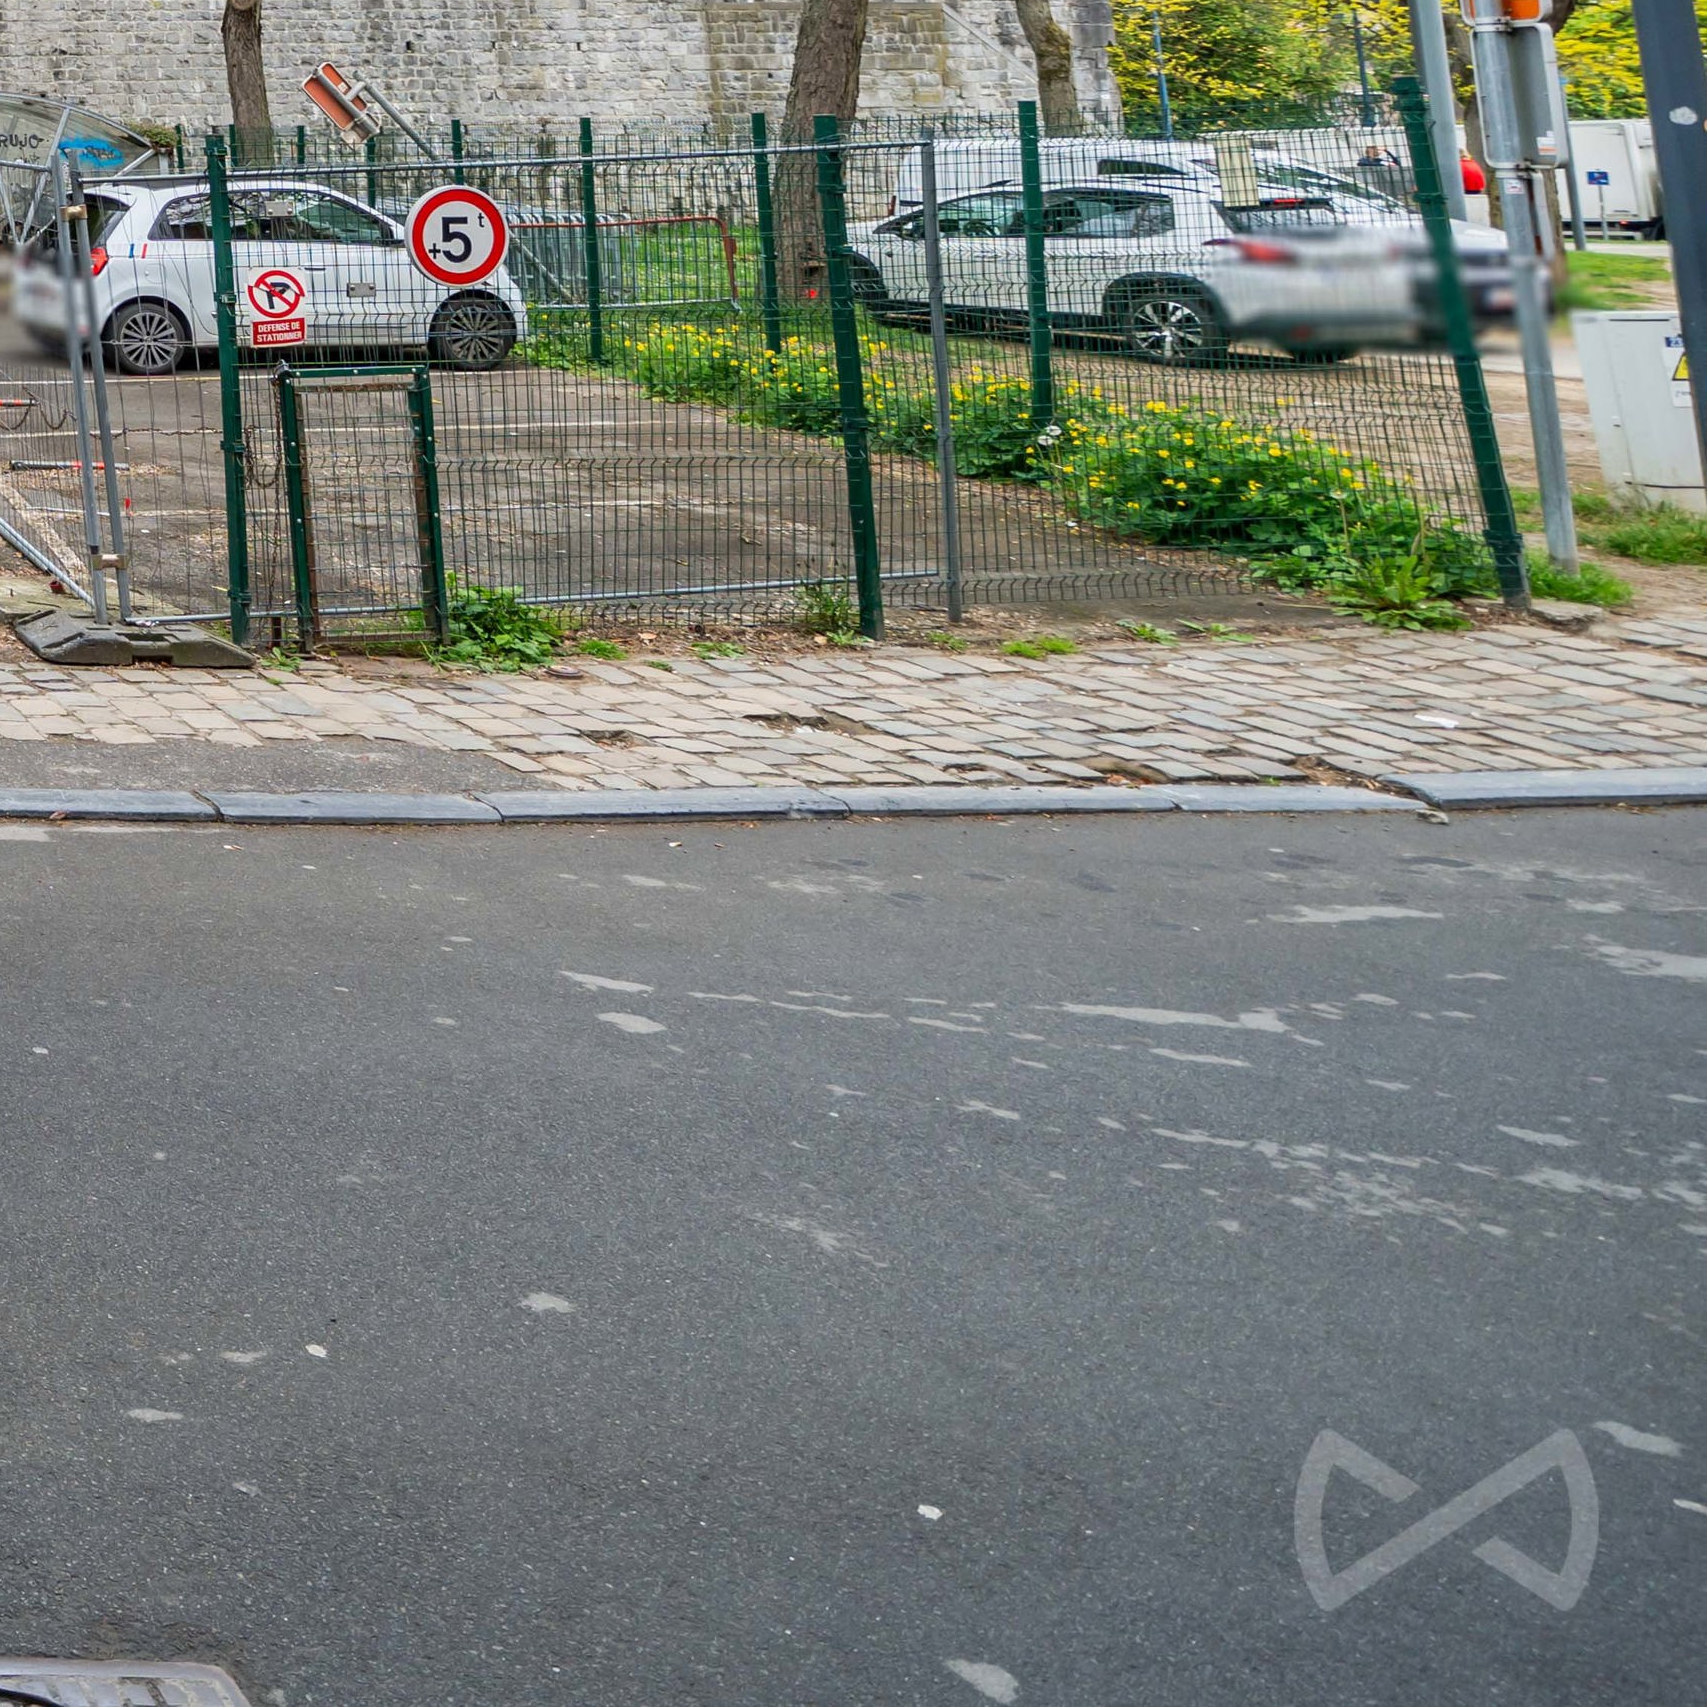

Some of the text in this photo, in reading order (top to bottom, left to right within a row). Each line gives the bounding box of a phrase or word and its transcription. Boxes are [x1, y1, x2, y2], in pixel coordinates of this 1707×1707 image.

[258, 321, 300, 332] DEFENSE DE
[257, 331, 302, 342] STATIONNER
